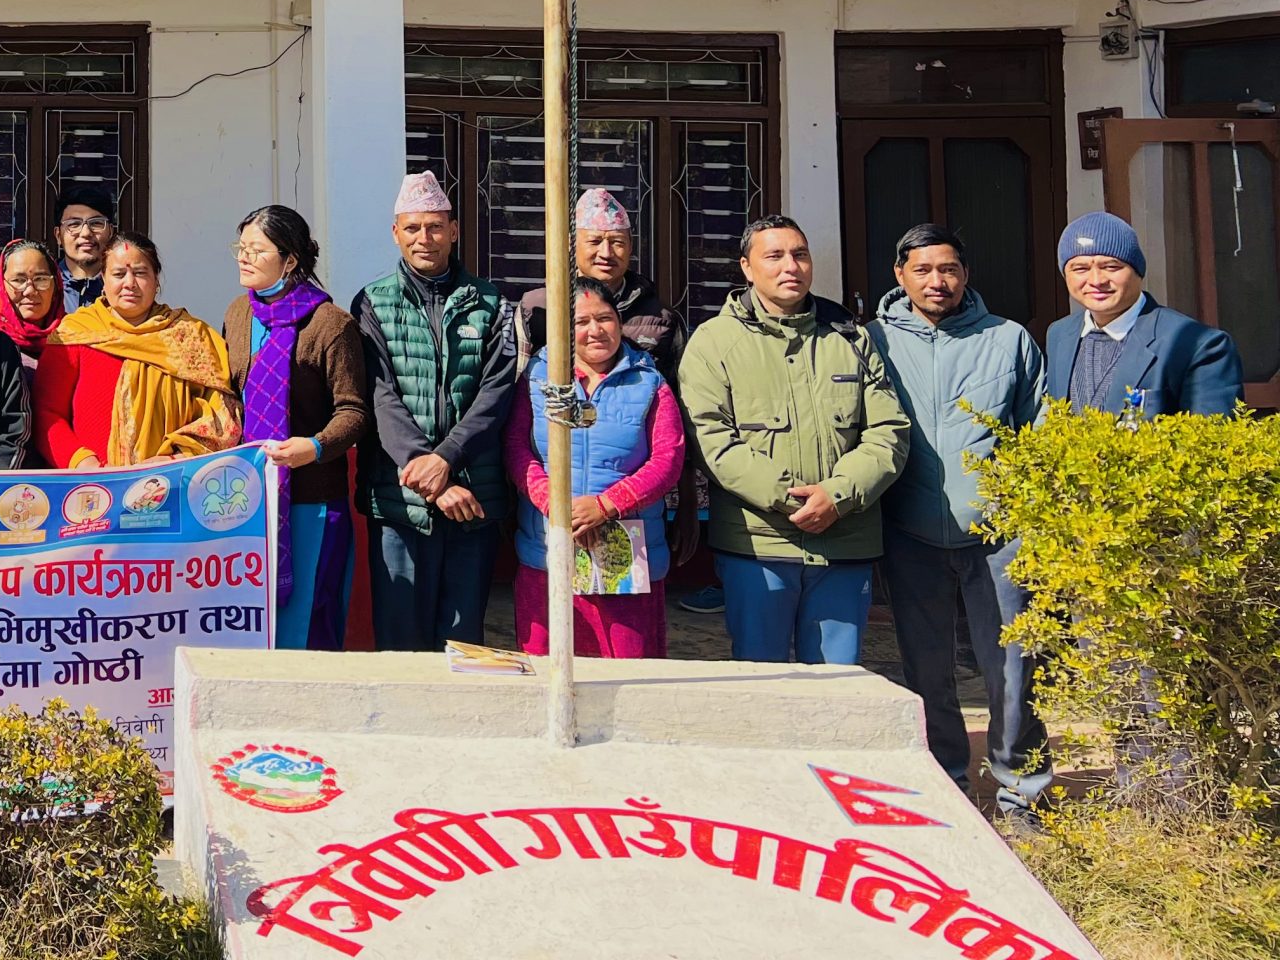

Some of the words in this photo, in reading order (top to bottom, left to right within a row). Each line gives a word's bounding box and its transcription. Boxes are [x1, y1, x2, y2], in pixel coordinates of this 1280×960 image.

[199, 605, 264, 634] तथा
[54, 648, 144, 685] गोष्ठी
[246, 808, 520, 957] त्रिवेणी
[492, 797, 1079, 960] गाउँपालिक
